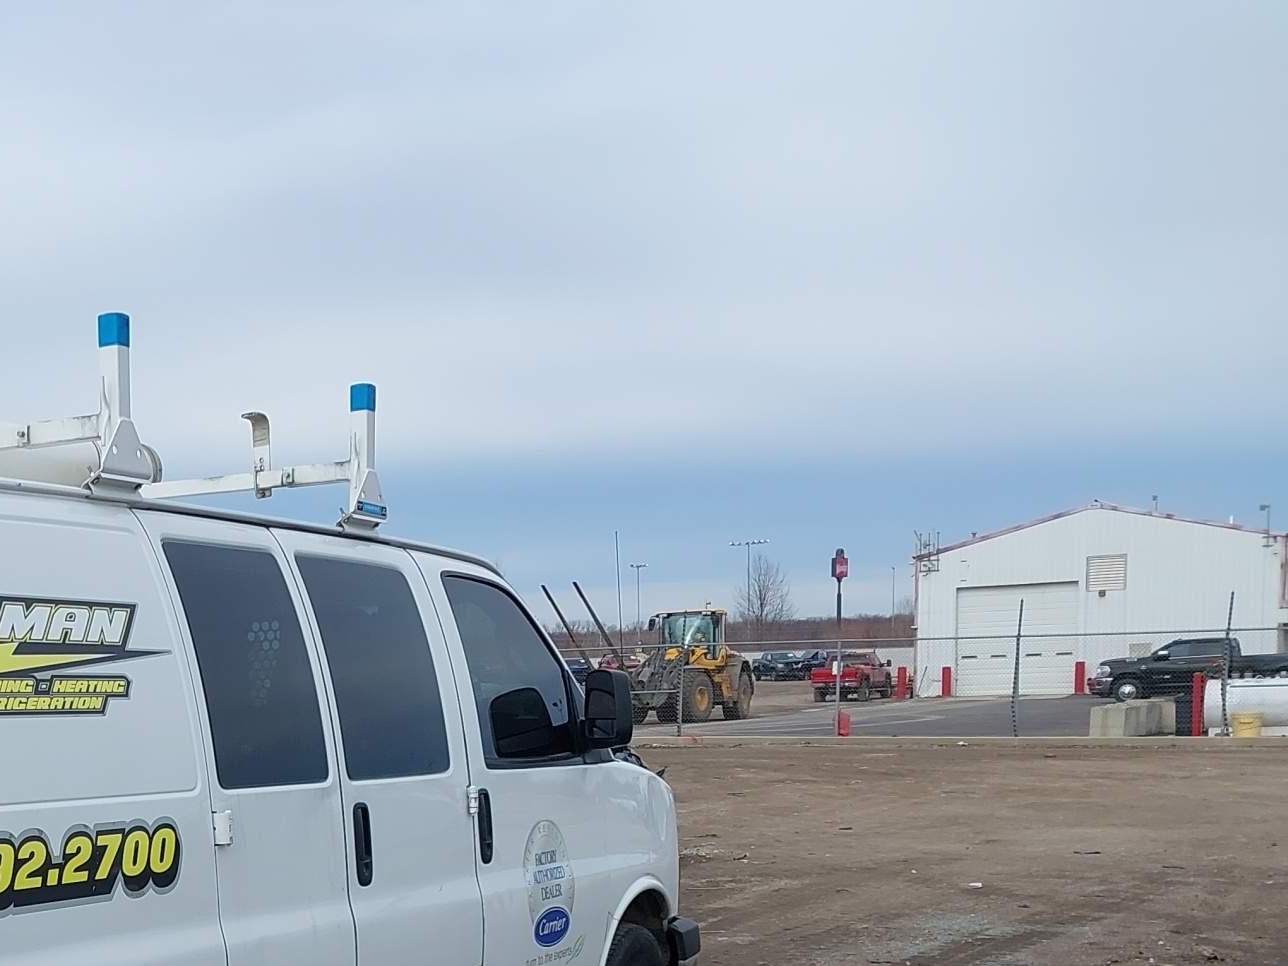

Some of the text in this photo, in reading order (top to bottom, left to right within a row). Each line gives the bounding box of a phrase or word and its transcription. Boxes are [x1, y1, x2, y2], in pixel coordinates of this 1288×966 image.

[52, 678, 127, 694] HEATING
[541, 884, 562, 901] DEALER
[539, 917, 566, 936] Carrier
